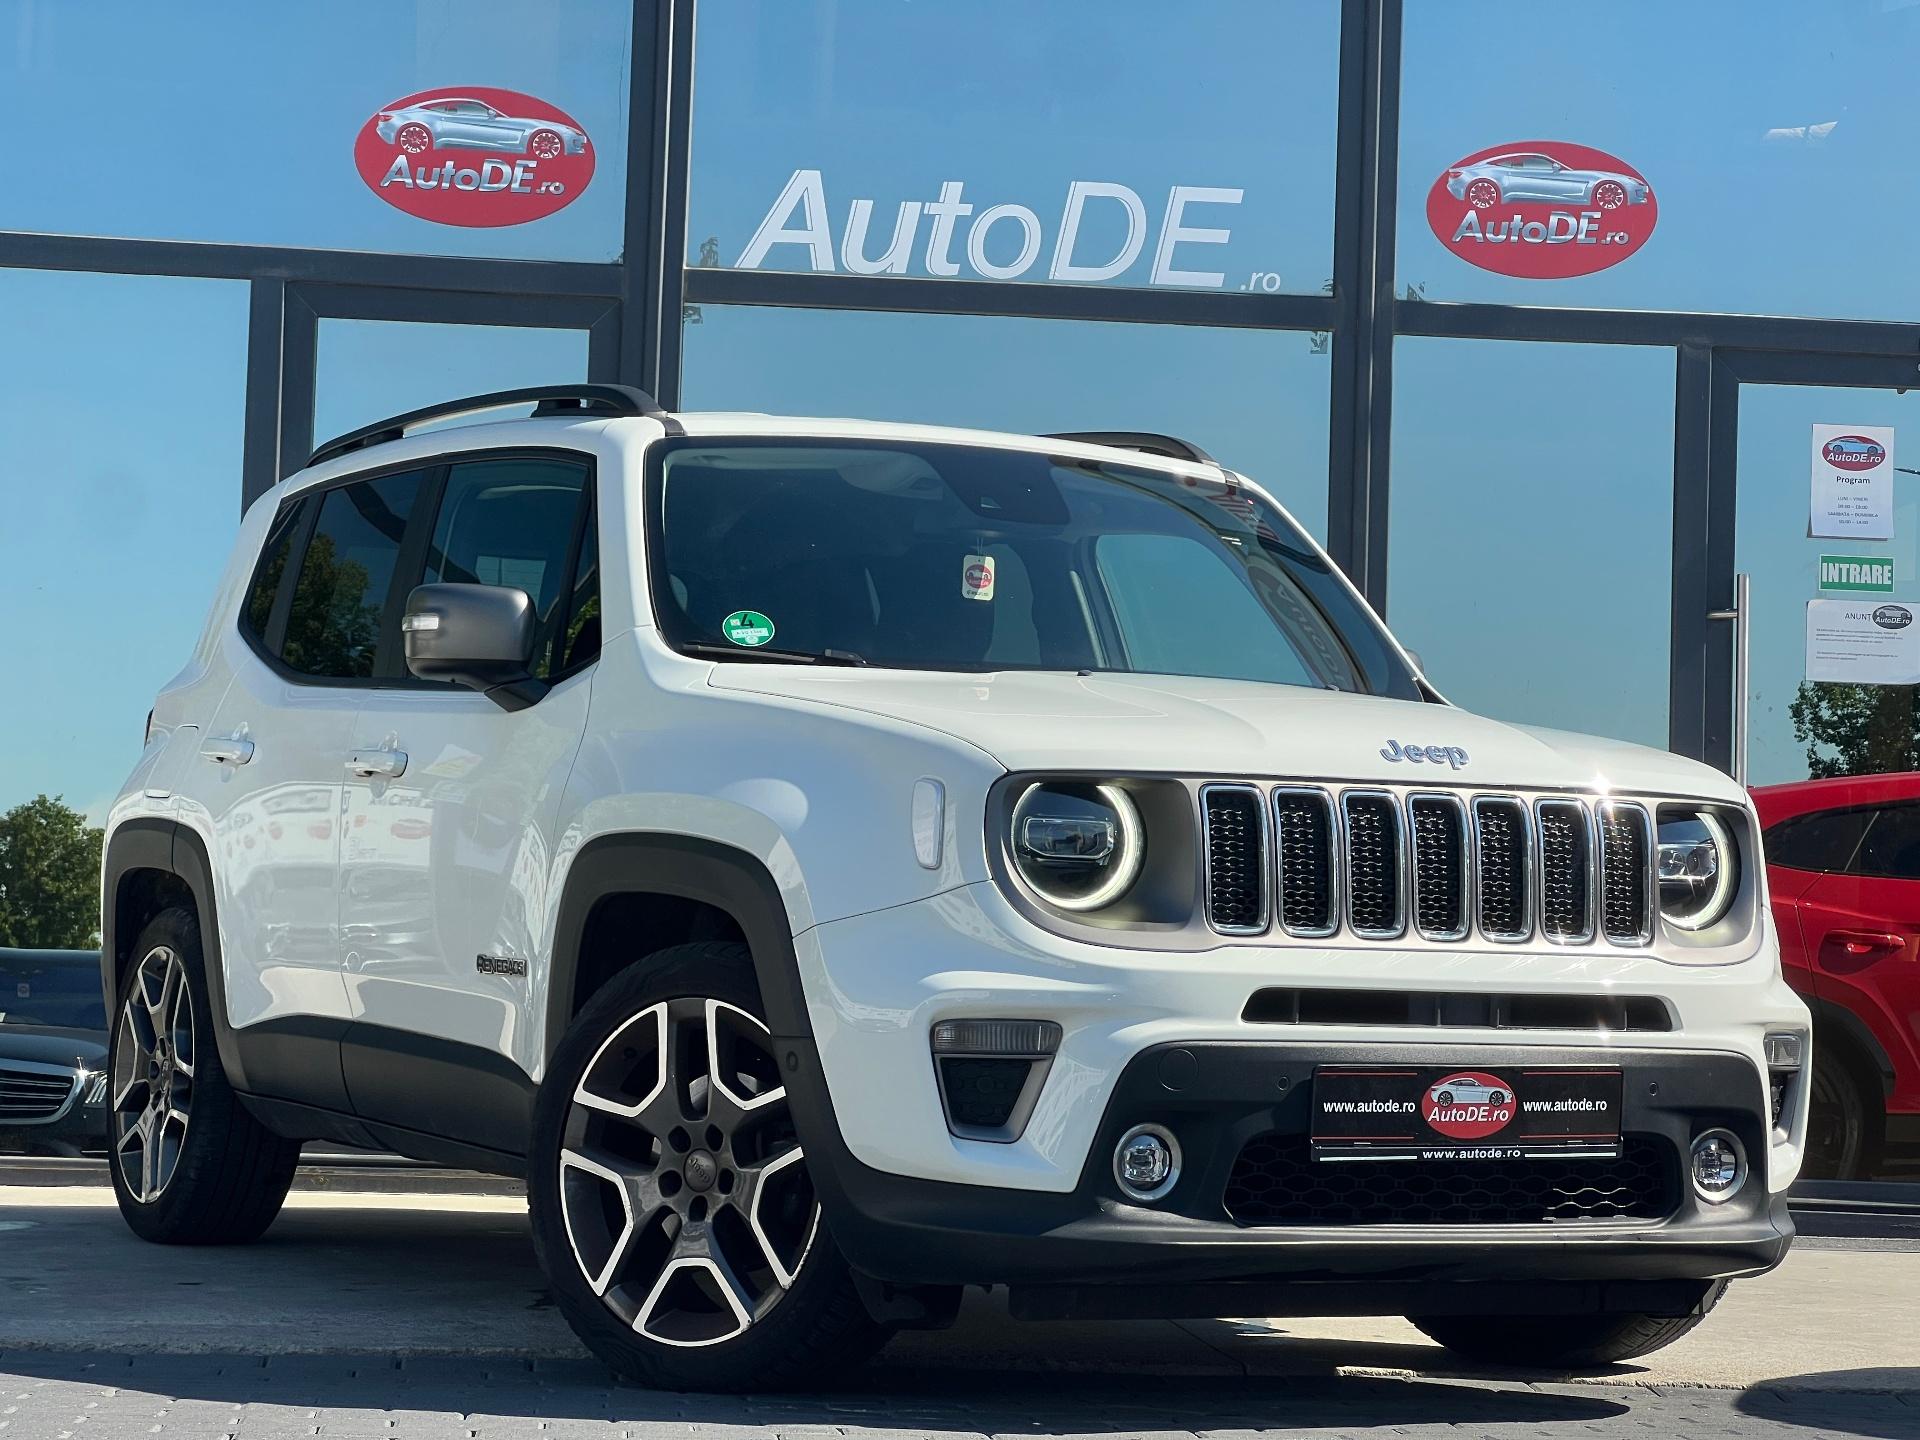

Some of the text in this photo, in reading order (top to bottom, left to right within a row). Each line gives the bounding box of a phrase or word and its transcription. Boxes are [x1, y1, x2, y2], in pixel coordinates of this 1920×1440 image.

[1826, 452, 1882, 463] AutoDE.ro
[1836, 475, 1871, 485] Program
[1822, 562, 1892, 585] INTRARE
[740, 613, 755, 629] 4
[1874, 616, 1911, 625] AutoDE.ro
[1379, 739, 1471, 771] Jeep
[1323, 1097, 1608, 1123] www.autode.ro AutoDE.ro www.autode.ro
[1422, 1148, 1521, 1160] www.autode.ro
